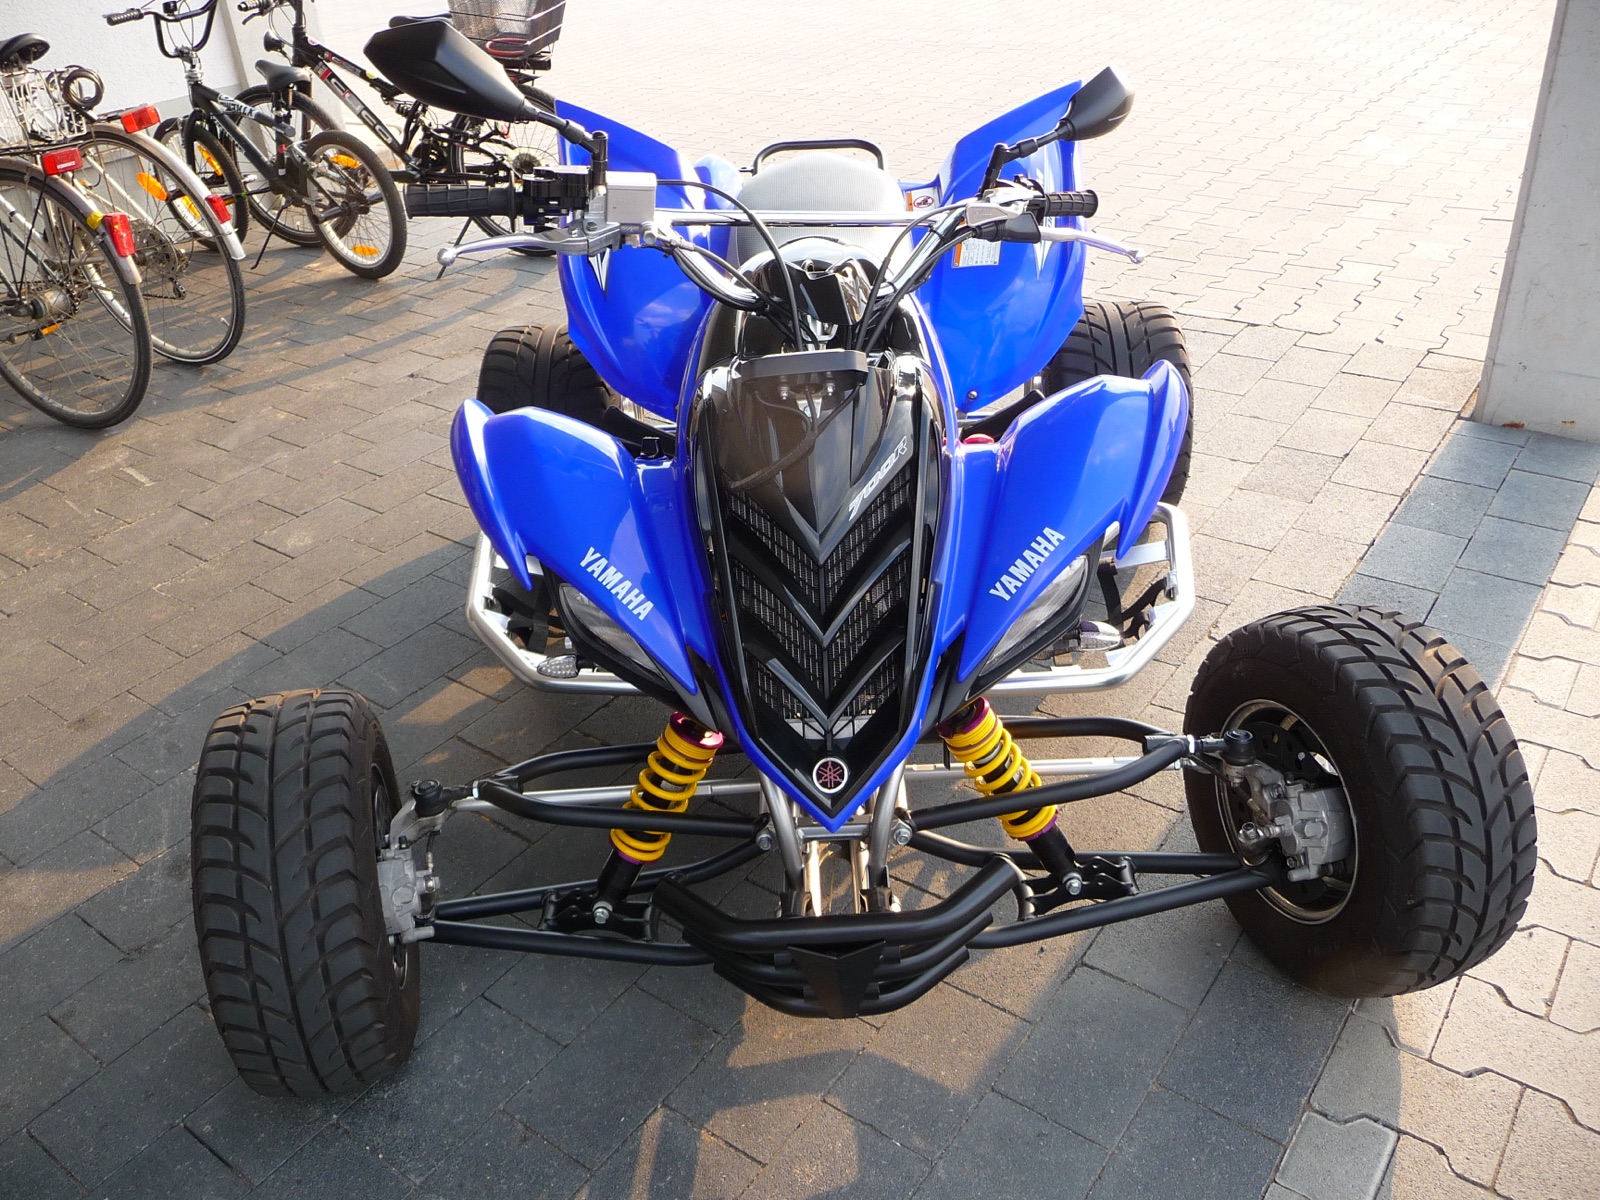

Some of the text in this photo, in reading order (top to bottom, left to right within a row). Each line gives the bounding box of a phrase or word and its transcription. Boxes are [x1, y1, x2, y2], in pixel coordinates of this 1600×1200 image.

[848, 435, 908, 522] 700R
[579, 546, 654, 621] YAMAHA
[988, 526, 1066, 601] YAMAHA
